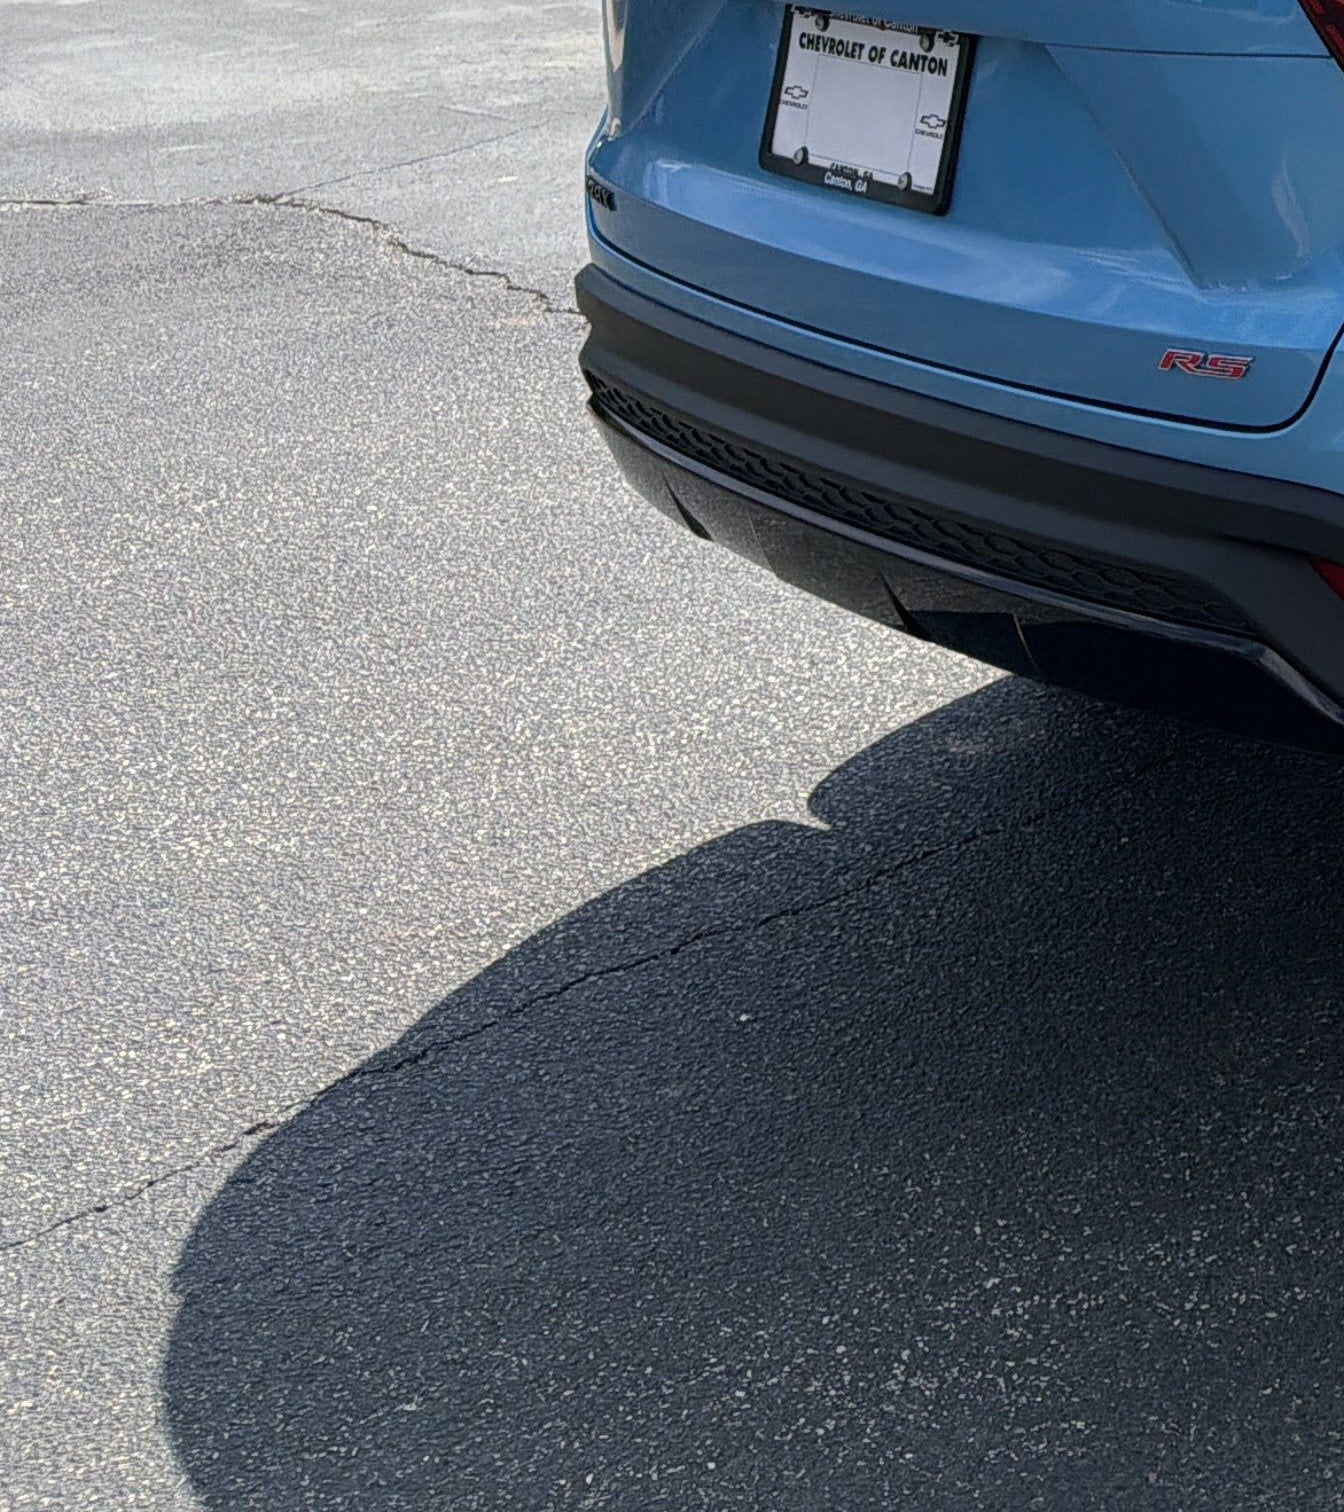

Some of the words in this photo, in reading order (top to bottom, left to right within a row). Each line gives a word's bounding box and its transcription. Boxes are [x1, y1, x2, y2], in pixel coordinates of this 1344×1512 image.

[799, 31, 865, 61] CHEVROLET
[868, 45, 887, 64] OF
[890, 49, 949, 77] CANTON
[1158, 348, 1254, 380] RS
